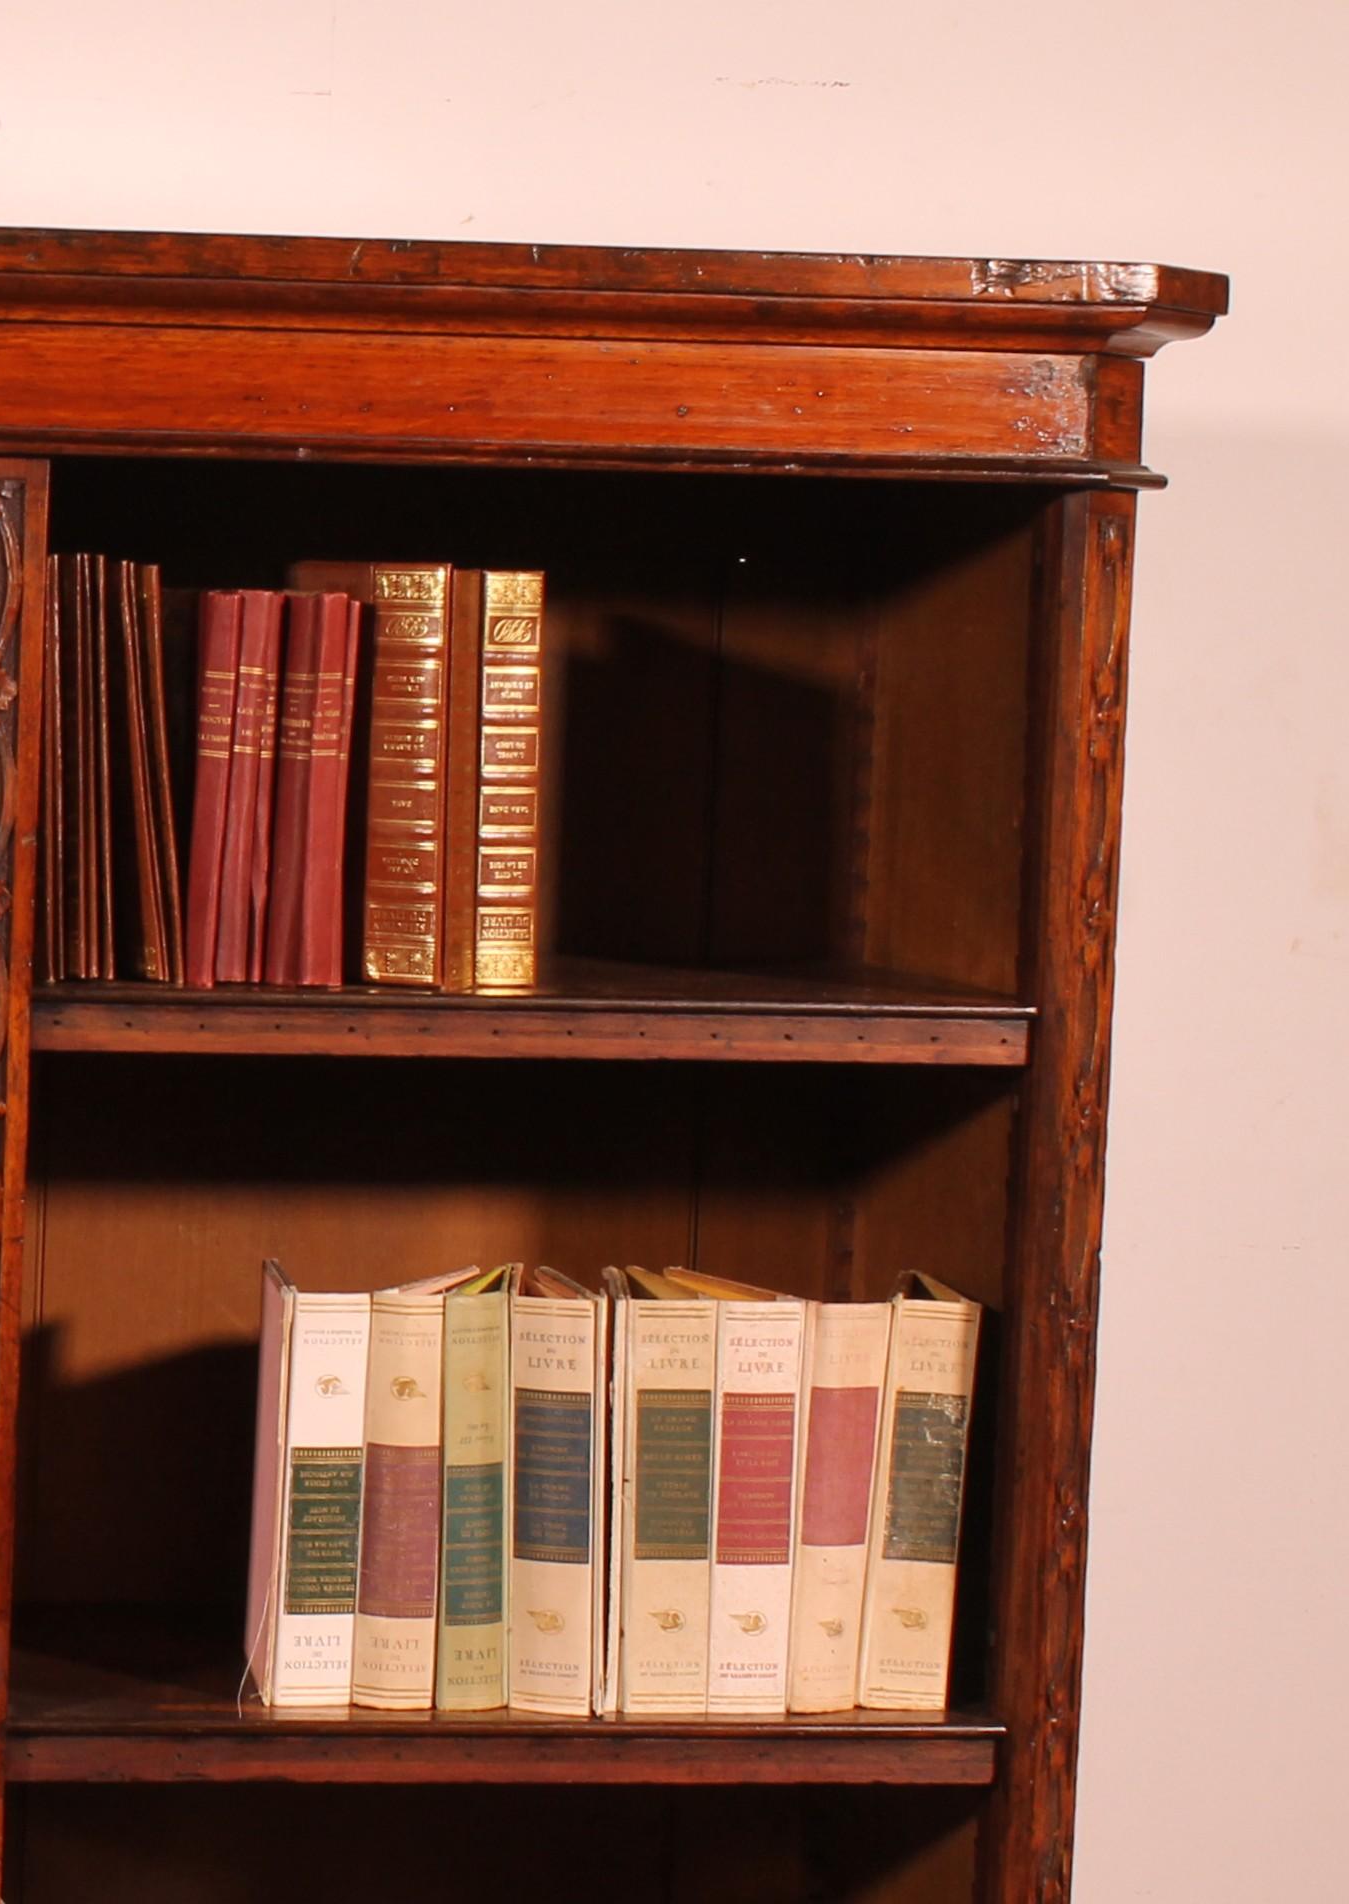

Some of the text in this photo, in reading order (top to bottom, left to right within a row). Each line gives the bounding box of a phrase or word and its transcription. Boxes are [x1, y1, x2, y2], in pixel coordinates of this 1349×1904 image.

[519, 1332, 587, 1344] SÉLECTION
[729, 1335, 793, 1348] SÉLECTION
[528, 1356, 577, 1371] LIVRE
[650, 1357, 700, 1370] LIVRE
[737, 1361, 785, 1374] LIVRE
[293, 1635, 341, 1648] LIVRE
[369, 1636, 419, 1650] LIVRE
[454, 1647, 497, 1661] LIVRE
